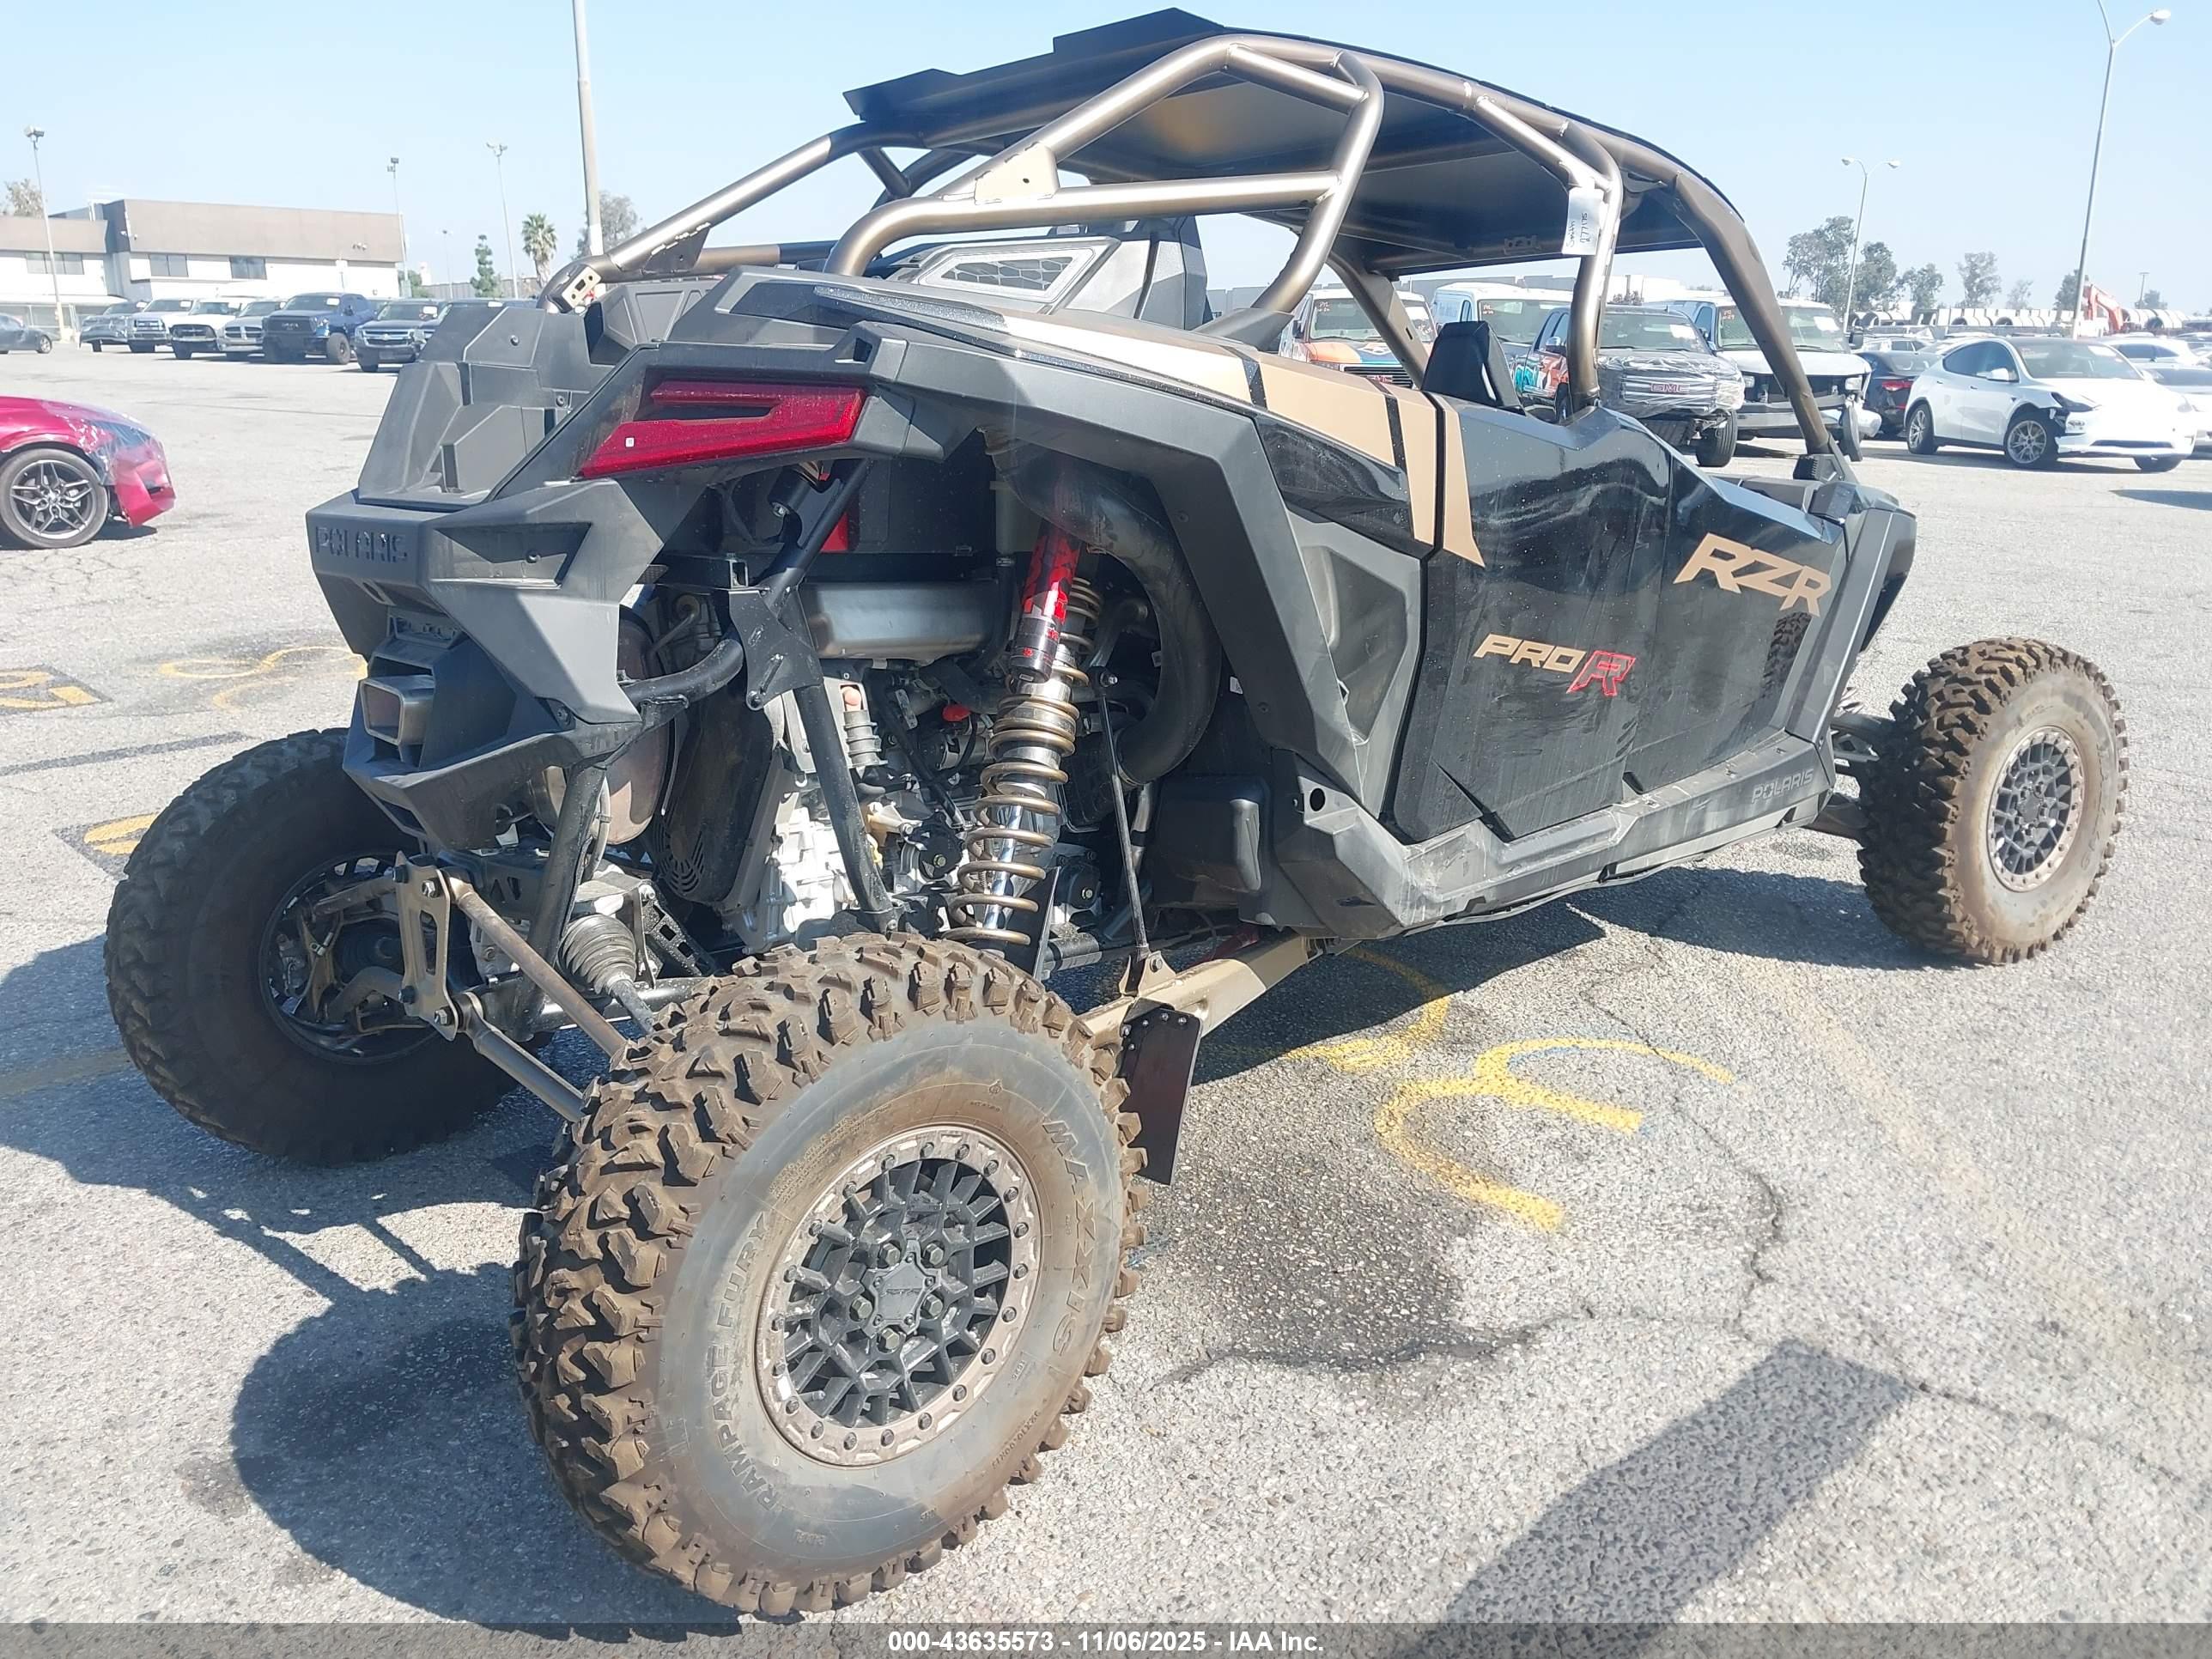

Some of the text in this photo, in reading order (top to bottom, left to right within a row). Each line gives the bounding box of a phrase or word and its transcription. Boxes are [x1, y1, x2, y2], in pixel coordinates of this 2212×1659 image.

[1565, 220, 1577, 248] Smith
[314, 525, 408, 562] POLARIS
[1672, 532, 1832, 617] RZR
[1473, 633, 1637, 696] PRO R
[1750, 768, 1814, 804] POLARIS
[1041, 1119, 1097, 1356] MAXXIS
[708, 1210, 781, 1511] RAMPAGE FURY
